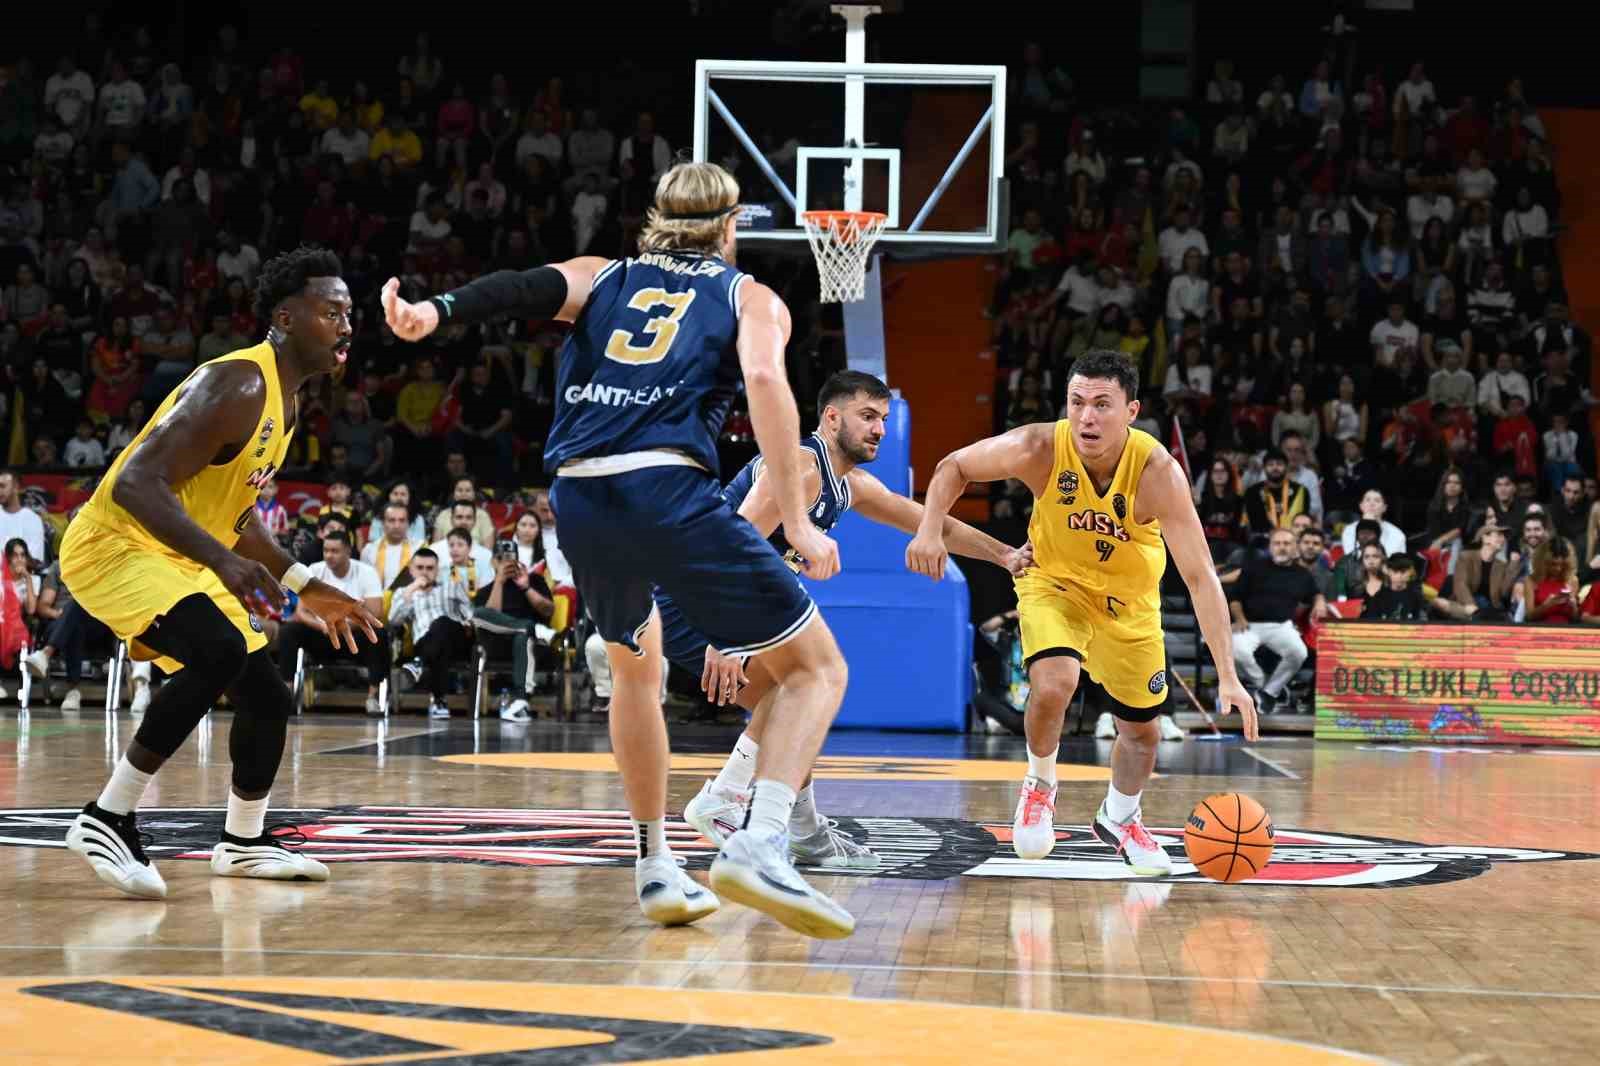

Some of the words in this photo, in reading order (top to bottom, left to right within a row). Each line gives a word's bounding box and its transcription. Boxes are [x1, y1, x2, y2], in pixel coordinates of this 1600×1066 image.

[604, 287, 697, 366] 3
[1069, 509, 1130, 542] MSK
[1095, 539, 1116, 562] 9
